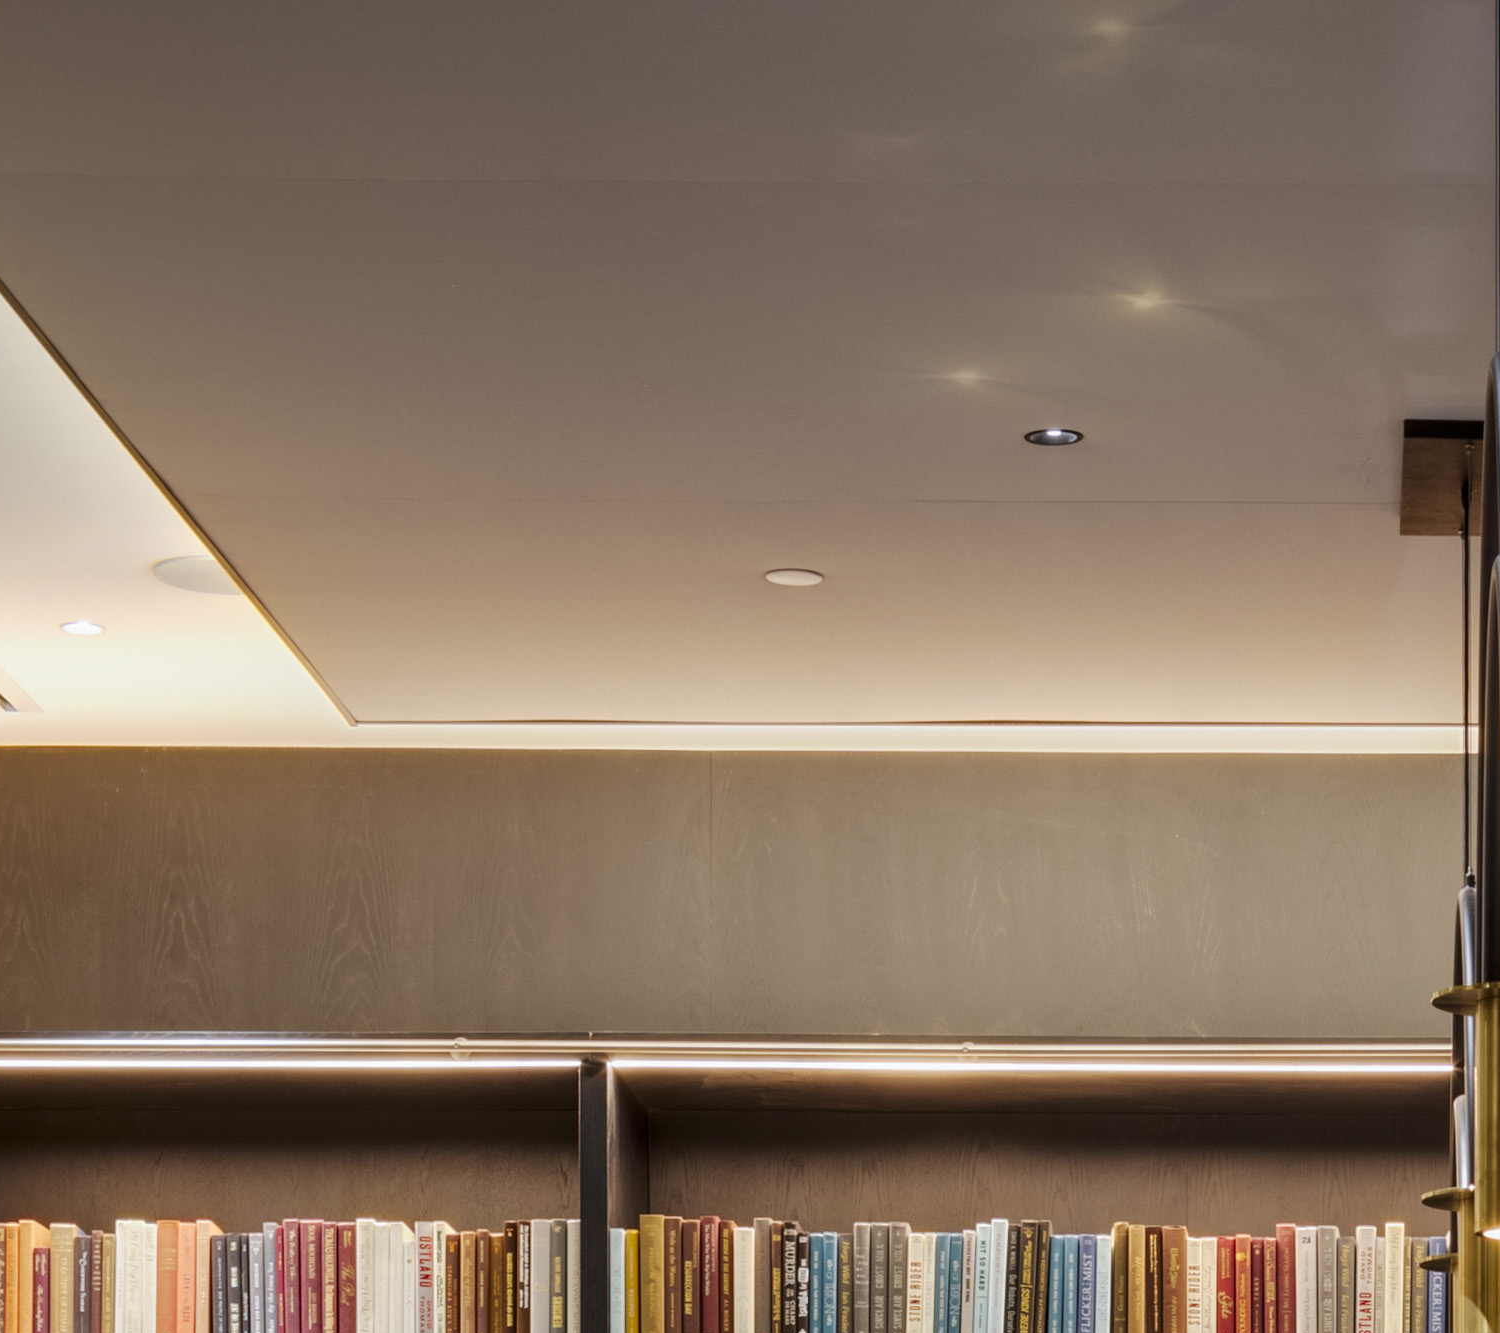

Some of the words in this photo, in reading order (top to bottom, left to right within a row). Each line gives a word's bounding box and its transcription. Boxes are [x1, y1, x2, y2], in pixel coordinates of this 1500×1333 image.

[419, 1236, 432, 1288] OSTLAND
[785, 1240, 795, 1286] MURDER
[841, 1241, 850, 1263] Hogs
[909, 1261, 921, 1289] RIDER
[1081, 1252, 1092, 1281] MIST
[1188, 1265, 1200, 1293] RIDER
[1432, 1270, 1443, 1306] ICKER
[841, 1306, 850, 1333] Frazier
[909, 1295, 921, 1322] STONE
[1081, 1287, 1092, 1333] FLICKER
[1188, 1298, 1200, 1326] STONE
